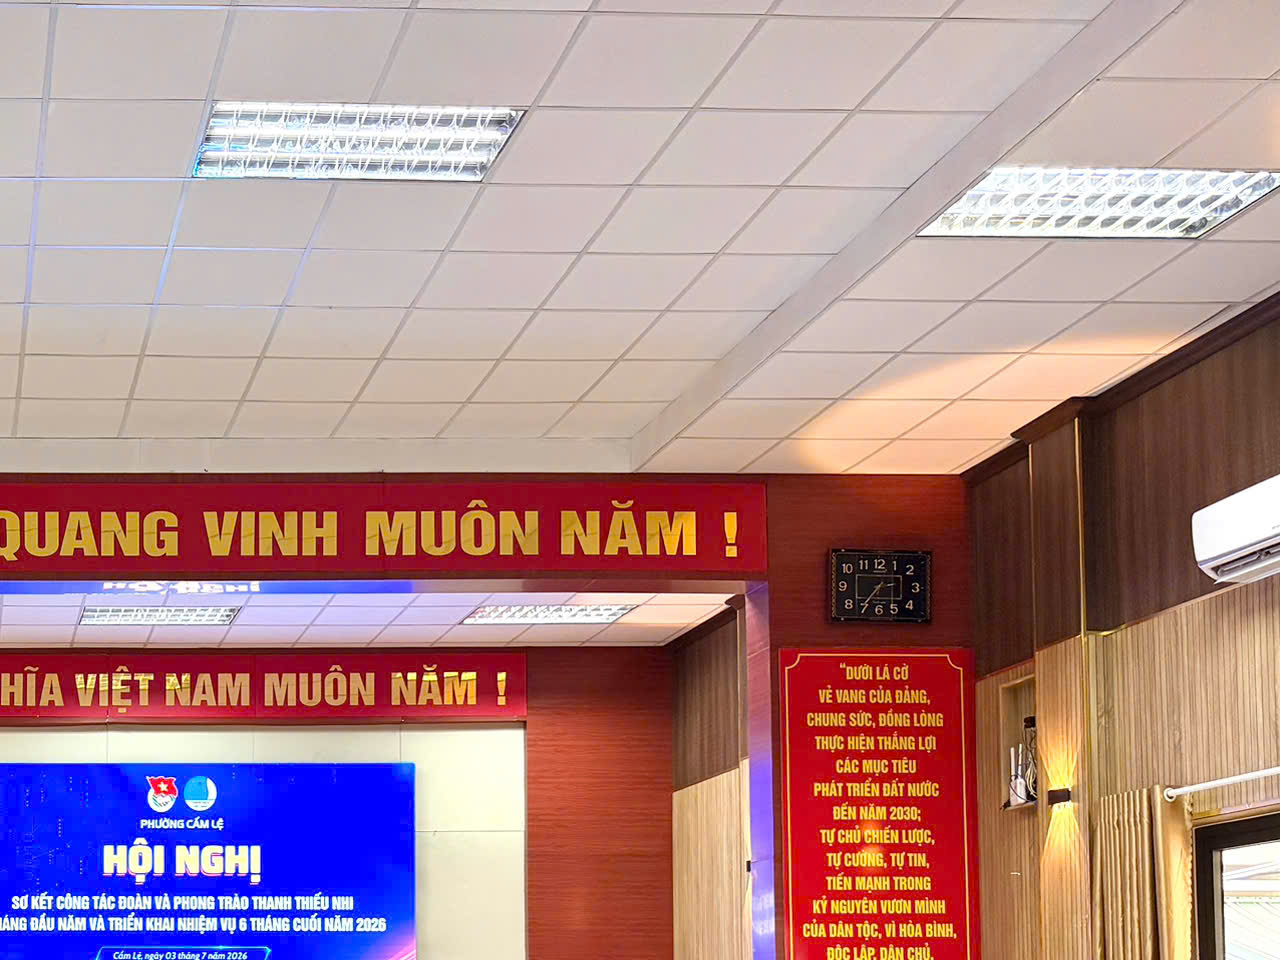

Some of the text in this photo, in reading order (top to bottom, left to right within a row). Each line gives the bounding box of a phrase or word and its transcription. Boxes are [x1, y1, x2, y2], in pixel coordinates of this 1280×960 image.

[204, 511, 338, 557] VINH
[365, 500, 538, 556] MUÔN
[561, 500, 697, 556] NĂM
[723, 511, 738, 558] !
[877, 664, 890, 680] LÁ
[894, 663, 908, 680] CỜ
[75, 666, 154, 714] VIỆT
[165, 672, 250, 707] NAM
[265, 665, 375, 707] MUÔN
[391, 665, 477, 706] NĂM
[496, 671, 507, 706] !
[807, 709, 943, 728] CHUNG SỨC, ĐỒNG LÒNG
[836, 757, 916, 776] CÁC MỤC TIÊU
[833, 802, 920, 821] ĐẾN NĂM 2030;
[140, 818, 184, 829] PHƯỜNG
[211, 818, 224, 831] LỆ
[103, 838, 261, 885] HỘI NGHỊ
[826, 872, 931, 893] TIẾN MẠNH TRONG
[12, 892, 354, 910] SƠ KẾT CÔNG TÁC ĐOÀN VÀ PHONG TRÀO THANH THIẾU NHI
[30, 913, 55, 931] ĐẦU
[58, 915, 87, 931] NĂM
[89, 915, 105, 931] VÀ
[108, 912, 143, 931] TRIỂN
[146, 917, 175, 931] KHAI
[178, 915, 218, 934] NHIỆM
[220, 917, 236, 934] VỤ
[239, 917, 247, 931] 6
[250, 915, 290, 931] THÁNG
[293, 913, 322, 931] CUỐI
[325, 915, 354, 931] NĂM
[356, 917, 387, 931] 2026
[165, 952, 176, 960] 03
[201, 952, 207, 960] 7
[208, 952, 225, 960] năm
[227, 952, 248, 960] 2026
